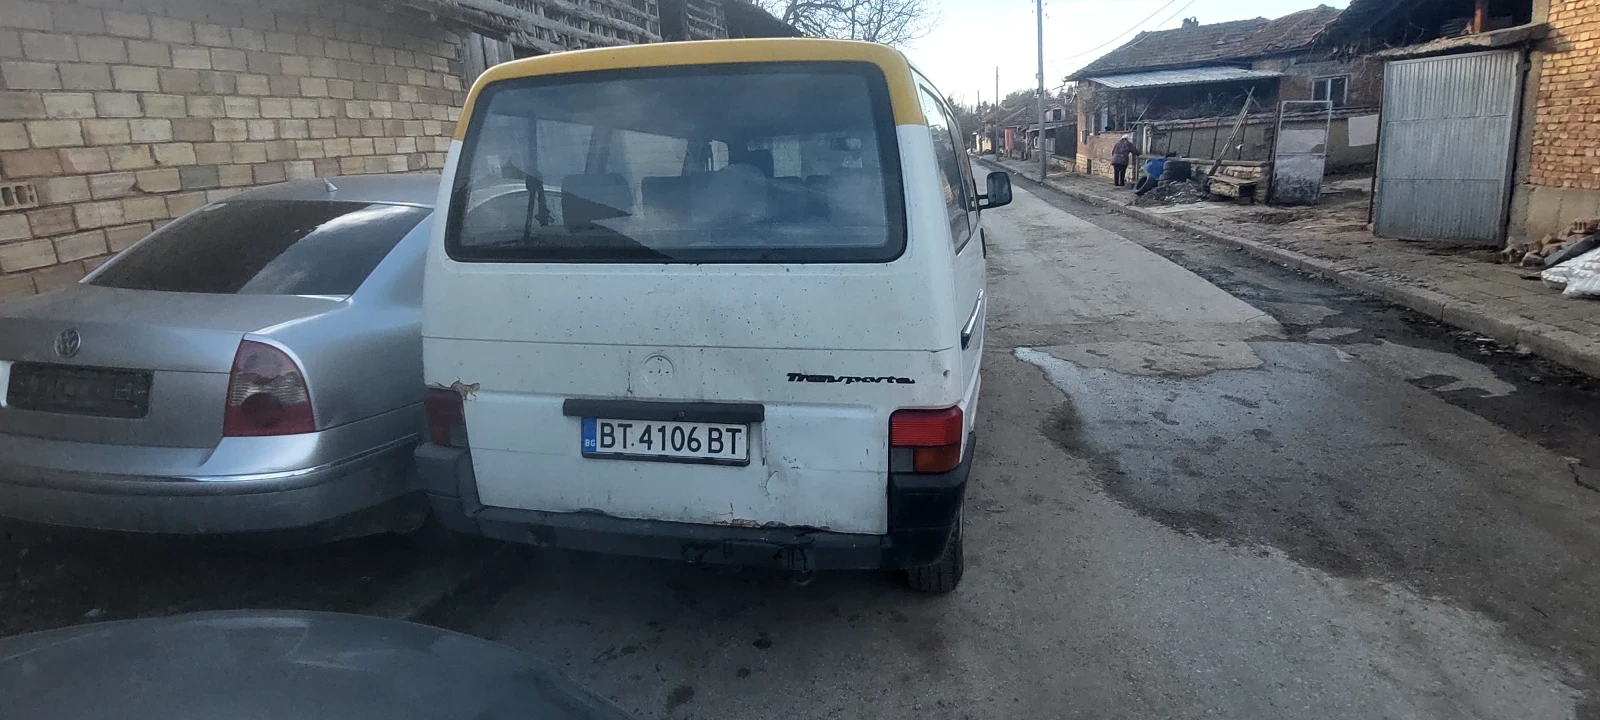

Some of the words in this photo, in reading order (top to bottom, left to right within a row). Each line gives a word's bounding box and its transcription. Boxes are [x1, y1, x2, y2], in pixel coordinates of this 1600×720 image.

[584, 438, 596, 447] BG
[600, 422, 633, 449] BT
[638, 424, 702, 453] 4106
[707, 427, 742, 455] BT
